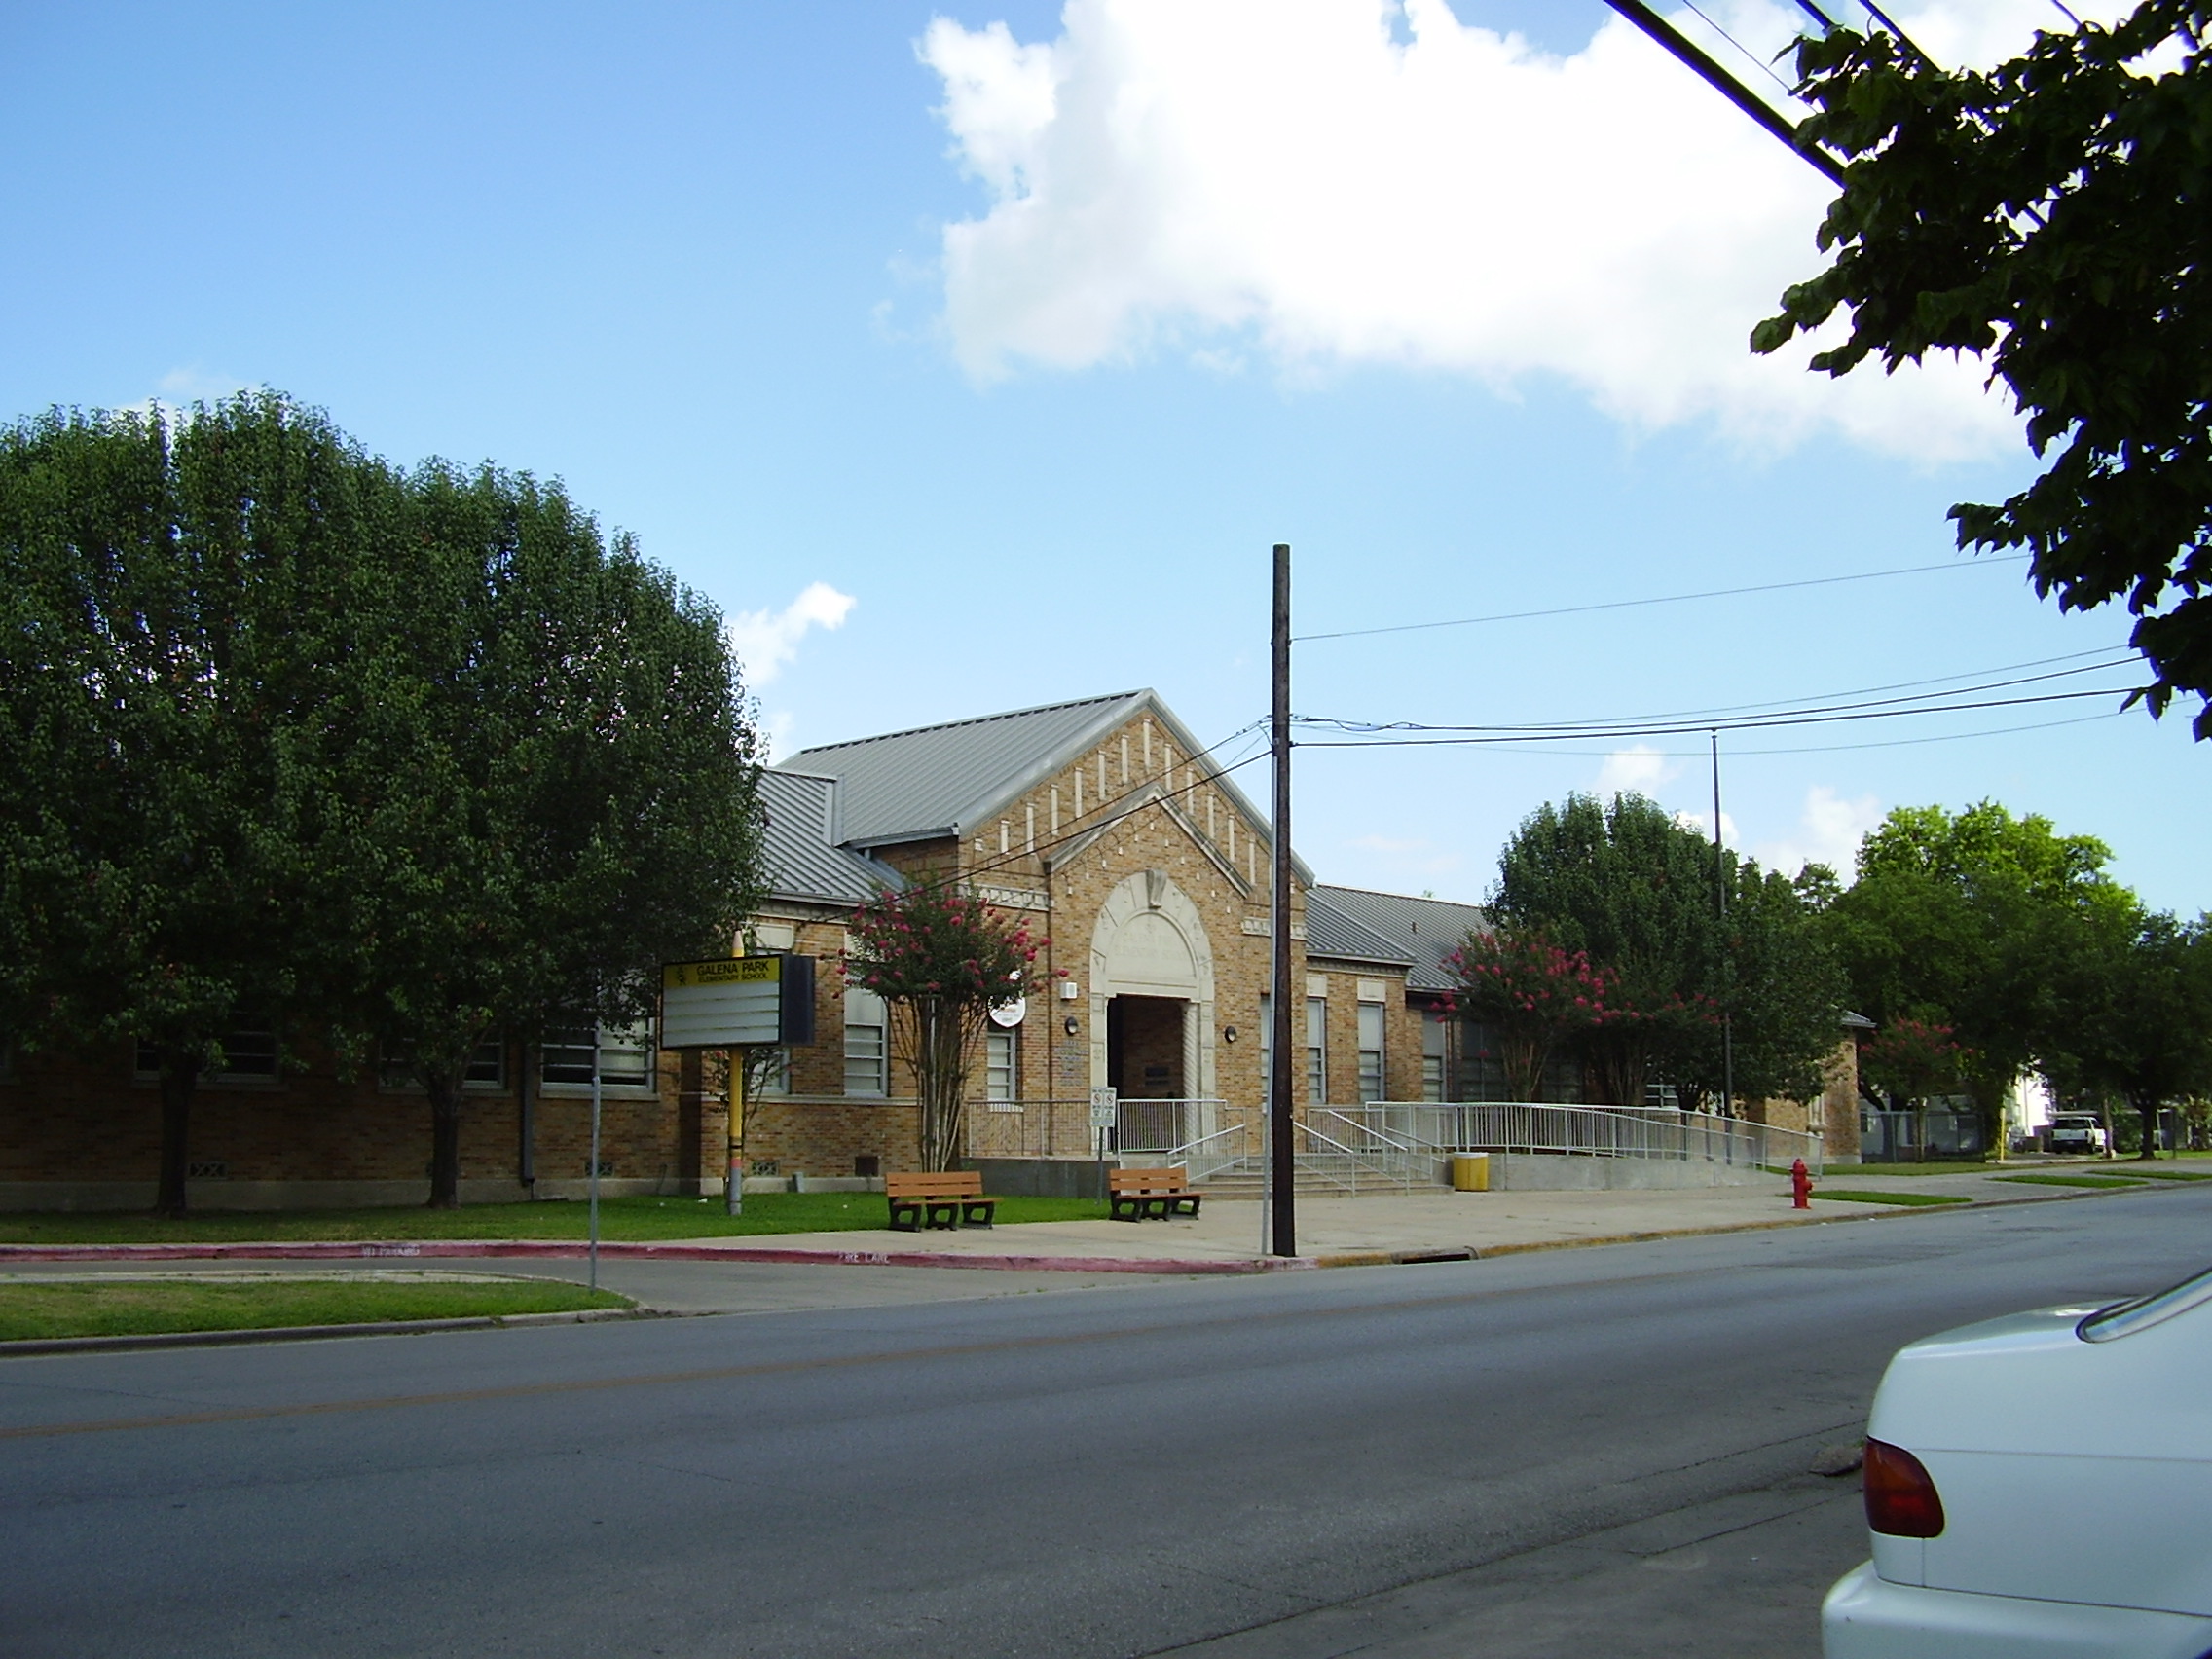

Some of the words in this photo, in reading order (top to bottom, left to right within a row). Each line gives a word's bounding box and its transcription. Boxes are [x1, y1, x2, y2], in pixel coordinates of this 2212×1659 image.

[697, 962, 738, 975] GALENA
[742, 960, 769, 972] PARK
[698, 974, 739, 983] ELEMENTARY
[741, 973, 767, 981] SCHOOL
